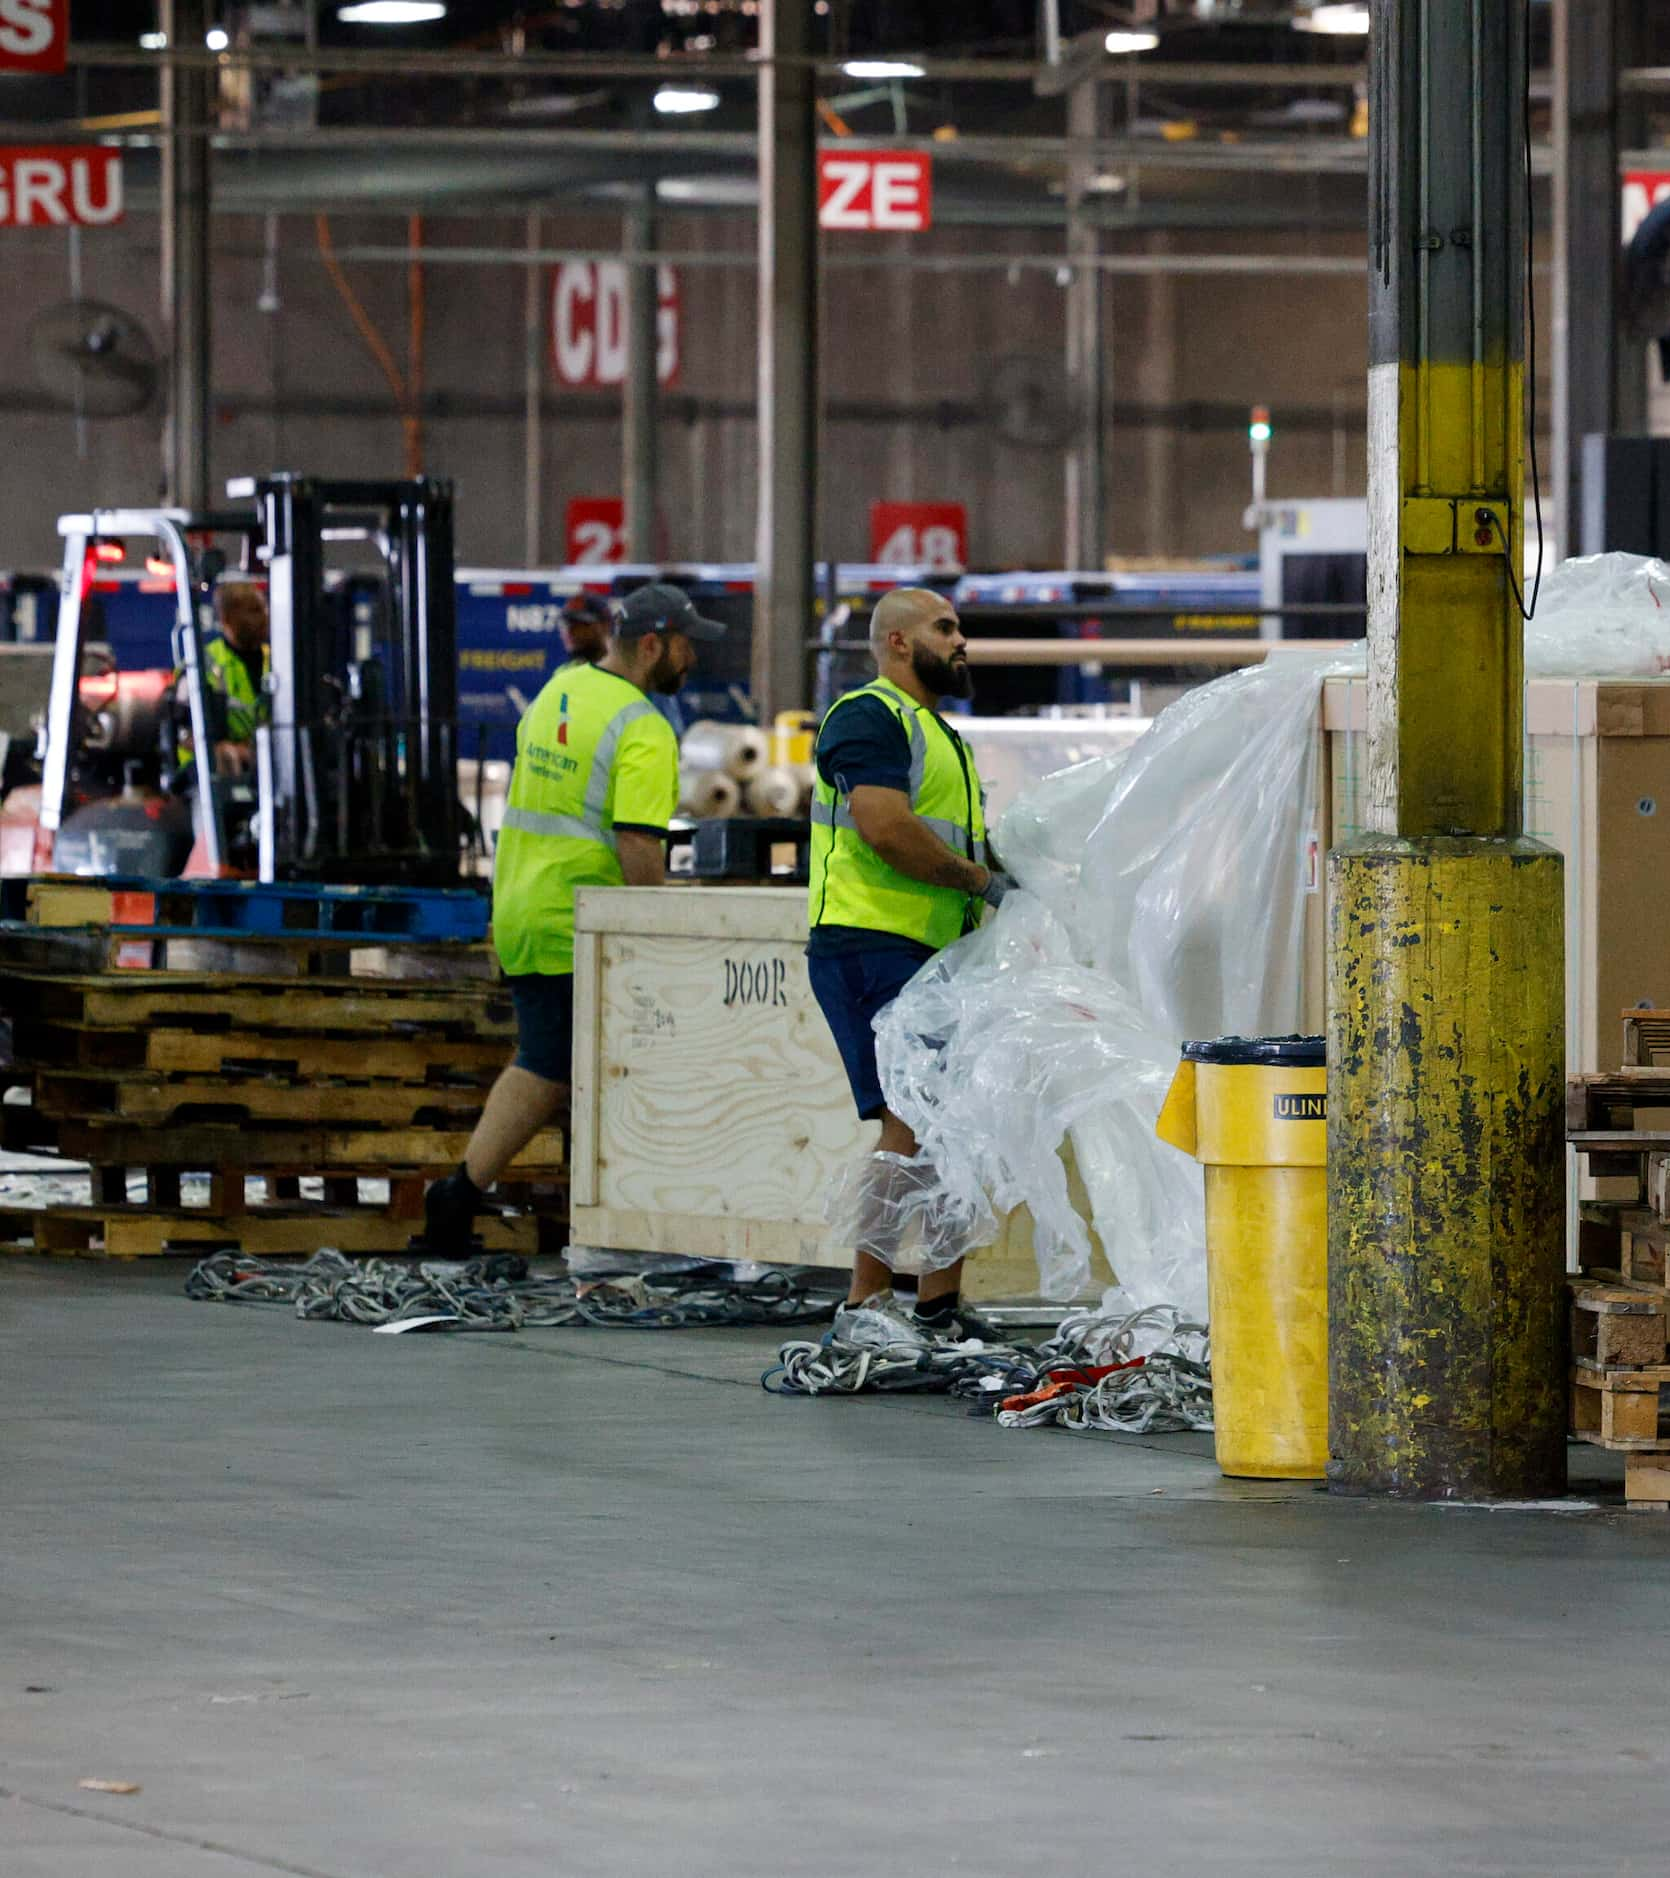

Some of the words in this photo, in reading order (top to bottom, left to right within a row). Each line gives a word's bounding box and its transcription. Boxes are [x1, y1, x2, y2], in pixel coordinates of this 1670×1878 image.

[819, 160, 921, 227] ZE
[879, 525, 960, 565] 48
[723, 958, 788, 1007] DOOR
